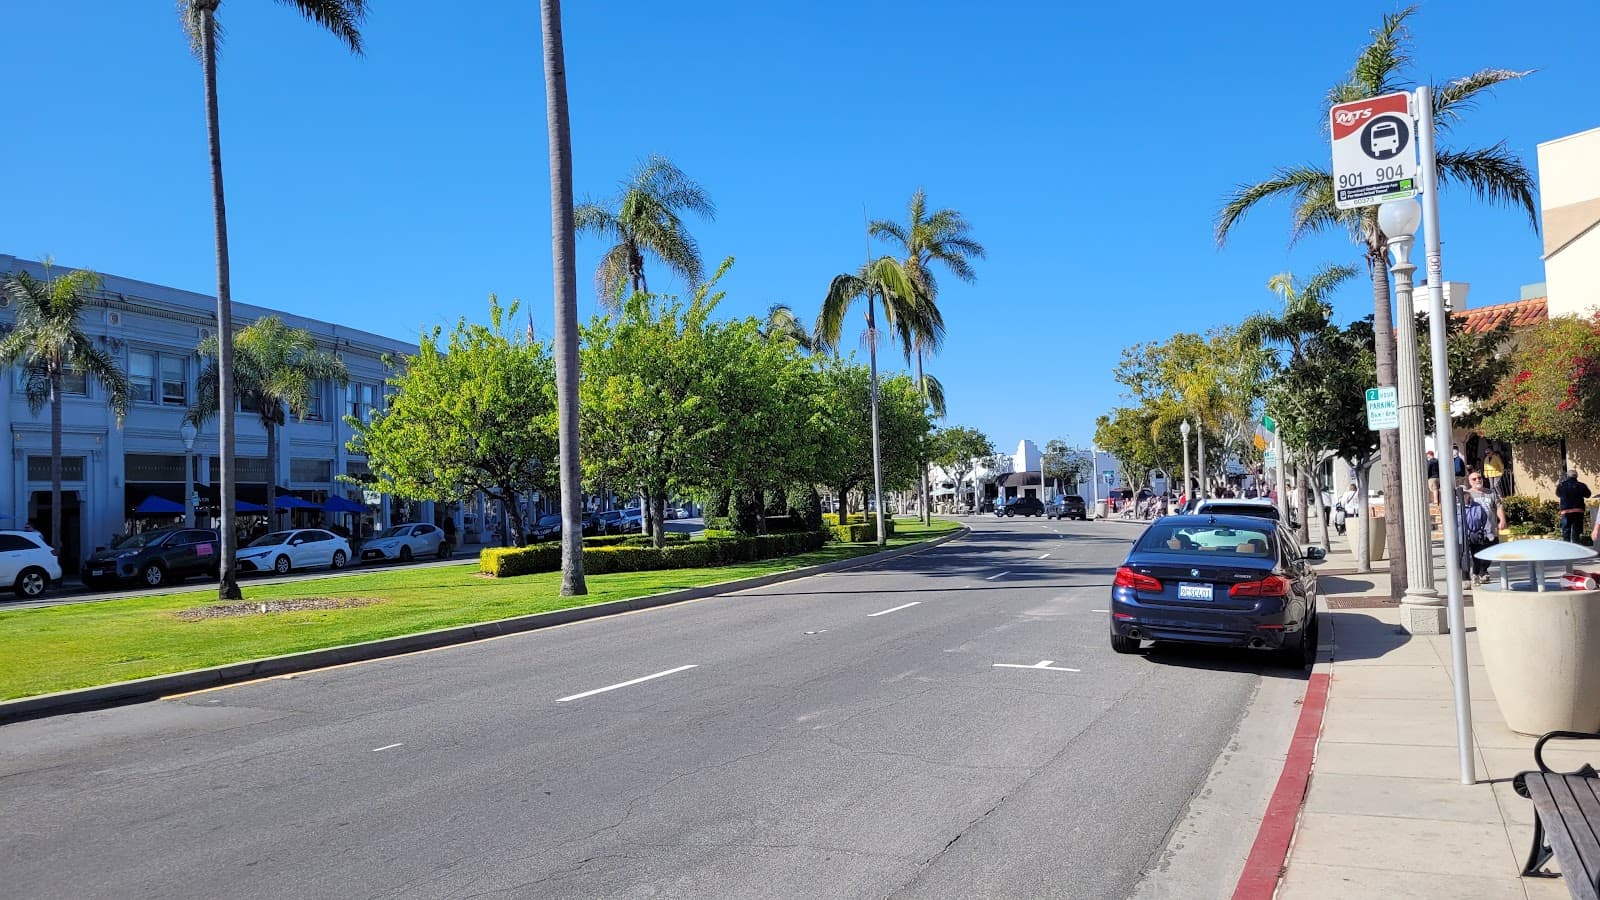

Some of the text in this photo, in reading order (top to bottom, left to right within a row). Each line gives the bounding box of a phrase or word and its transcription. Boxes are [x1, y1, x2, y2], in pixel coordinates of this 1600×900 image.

[1335, 108, 1372, 125] MTS
[1339, 164, 1404, 189] 901 904
[1370, 391, 1375, 399] 2
[1369, 401, 1395, 410] PARKING
